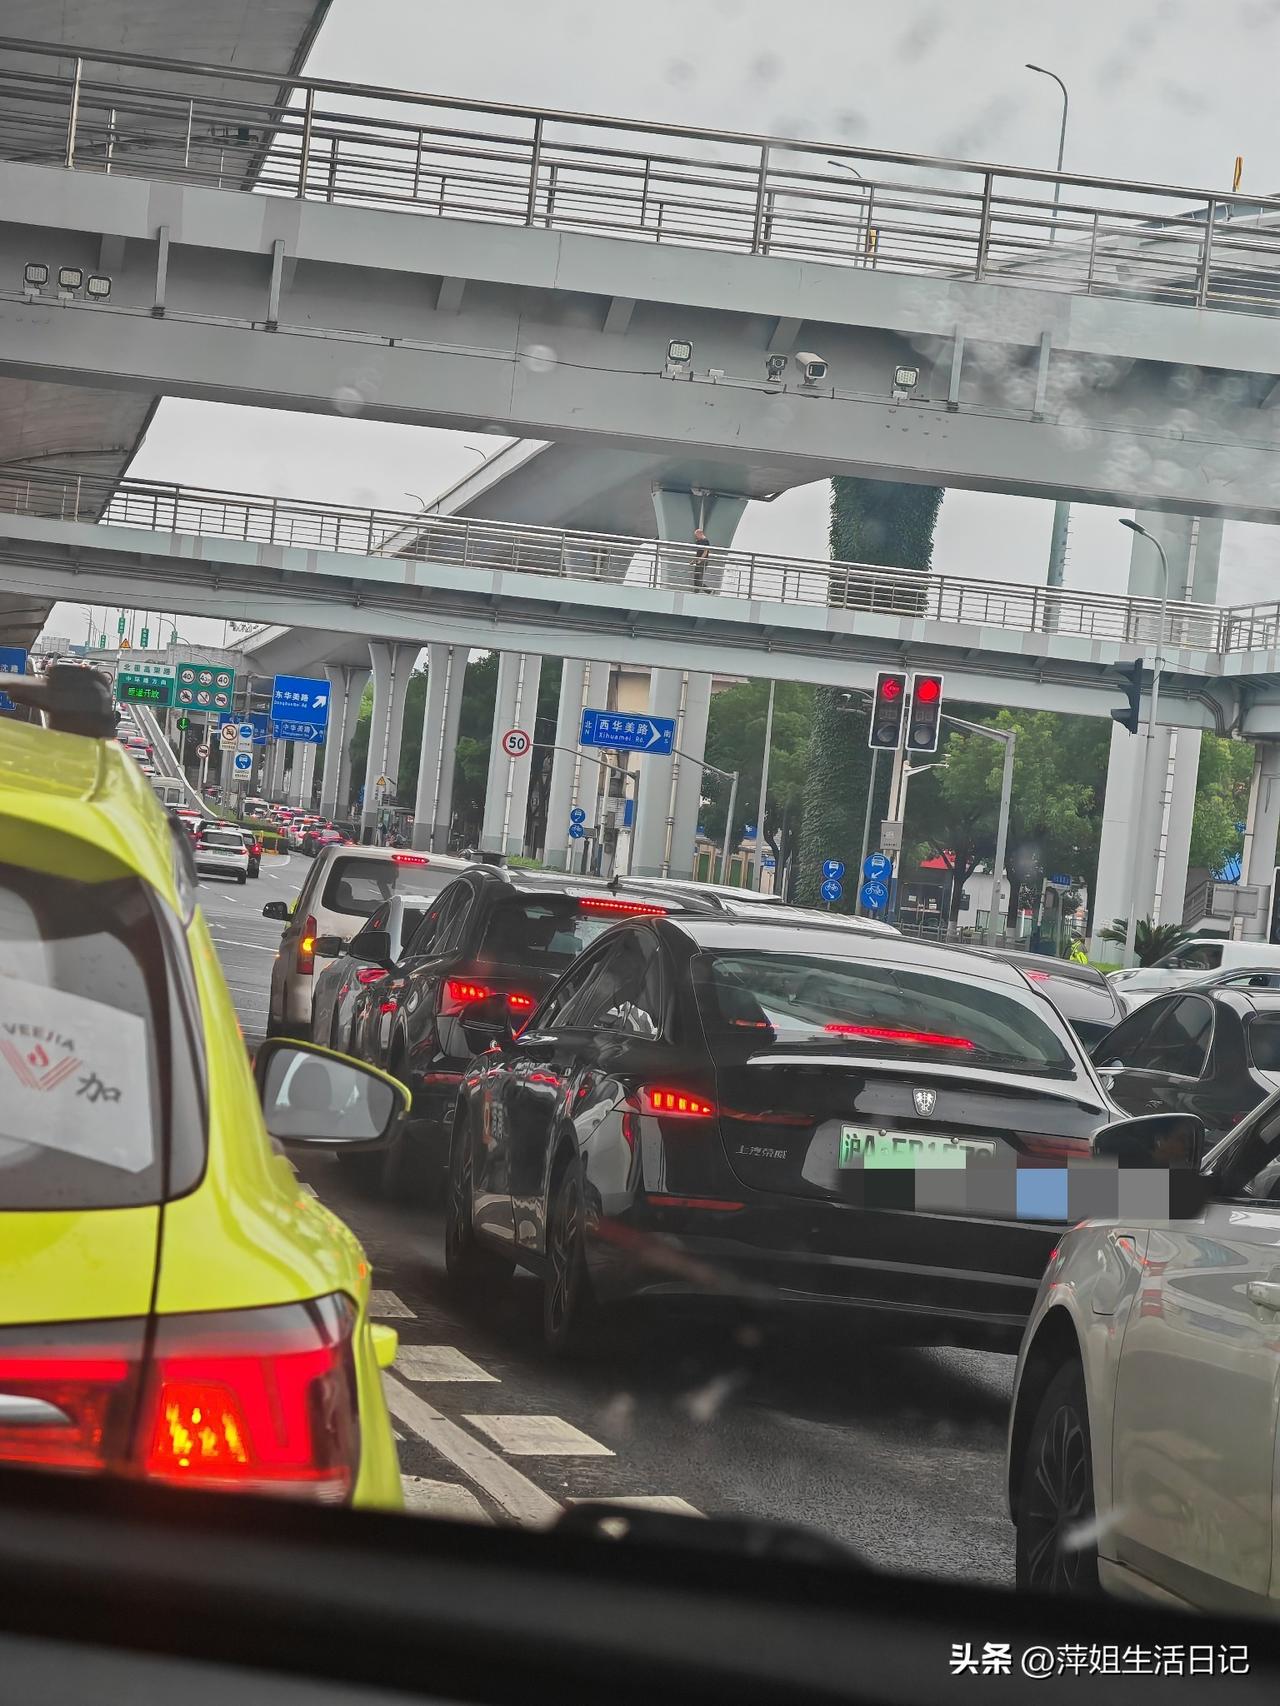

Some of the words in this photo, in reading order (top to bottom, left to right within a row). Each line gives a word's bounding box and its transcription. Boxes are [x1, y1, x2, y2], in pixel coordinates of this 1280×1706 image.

[217, 676, 228, 684] 40
[275, 690, 309, 702] 东华美路
[585, 720, 592, 729] 北
[599, 718, 649, 736] 西华美路
[508, 736, 525, 750] 50
[598, 731, 632, 742] Xihuamei
[2, 1022, 75, 1052] VEEJIA
[76, 1071, 123, 1104] 加
